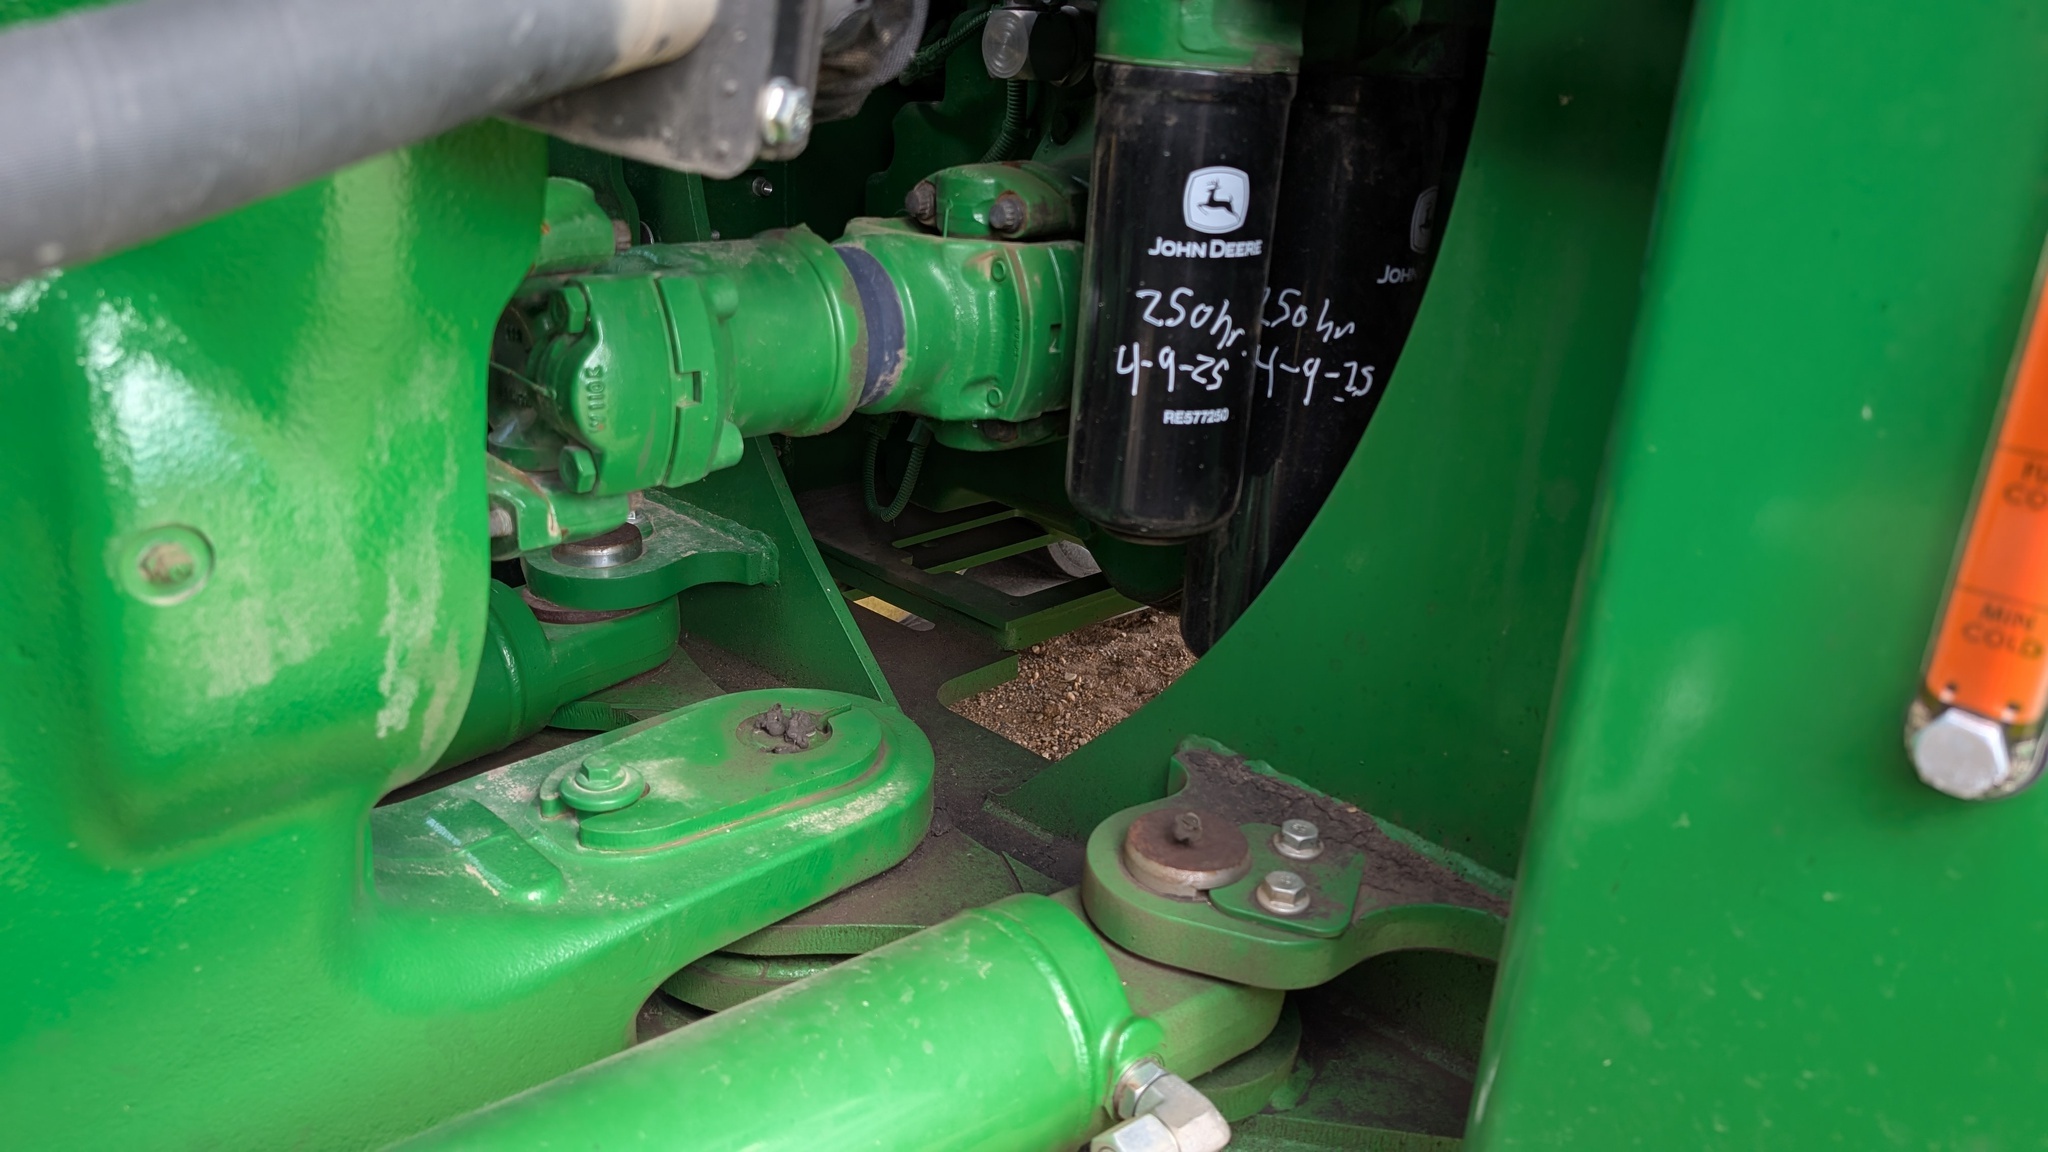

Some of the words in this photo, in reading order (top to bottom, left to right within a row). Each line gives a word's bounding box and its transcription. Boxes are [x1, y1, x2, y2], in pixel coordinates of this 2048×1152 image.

[1148, 236, 1207, 258] JOHN
[1209, 238, 1263, 259] DEERE
[1116, 341, 1230, 396] 4-9-25
[1163, 407, 1230, 426] RE577250
[1960, 621, 2043, 659] COLD
